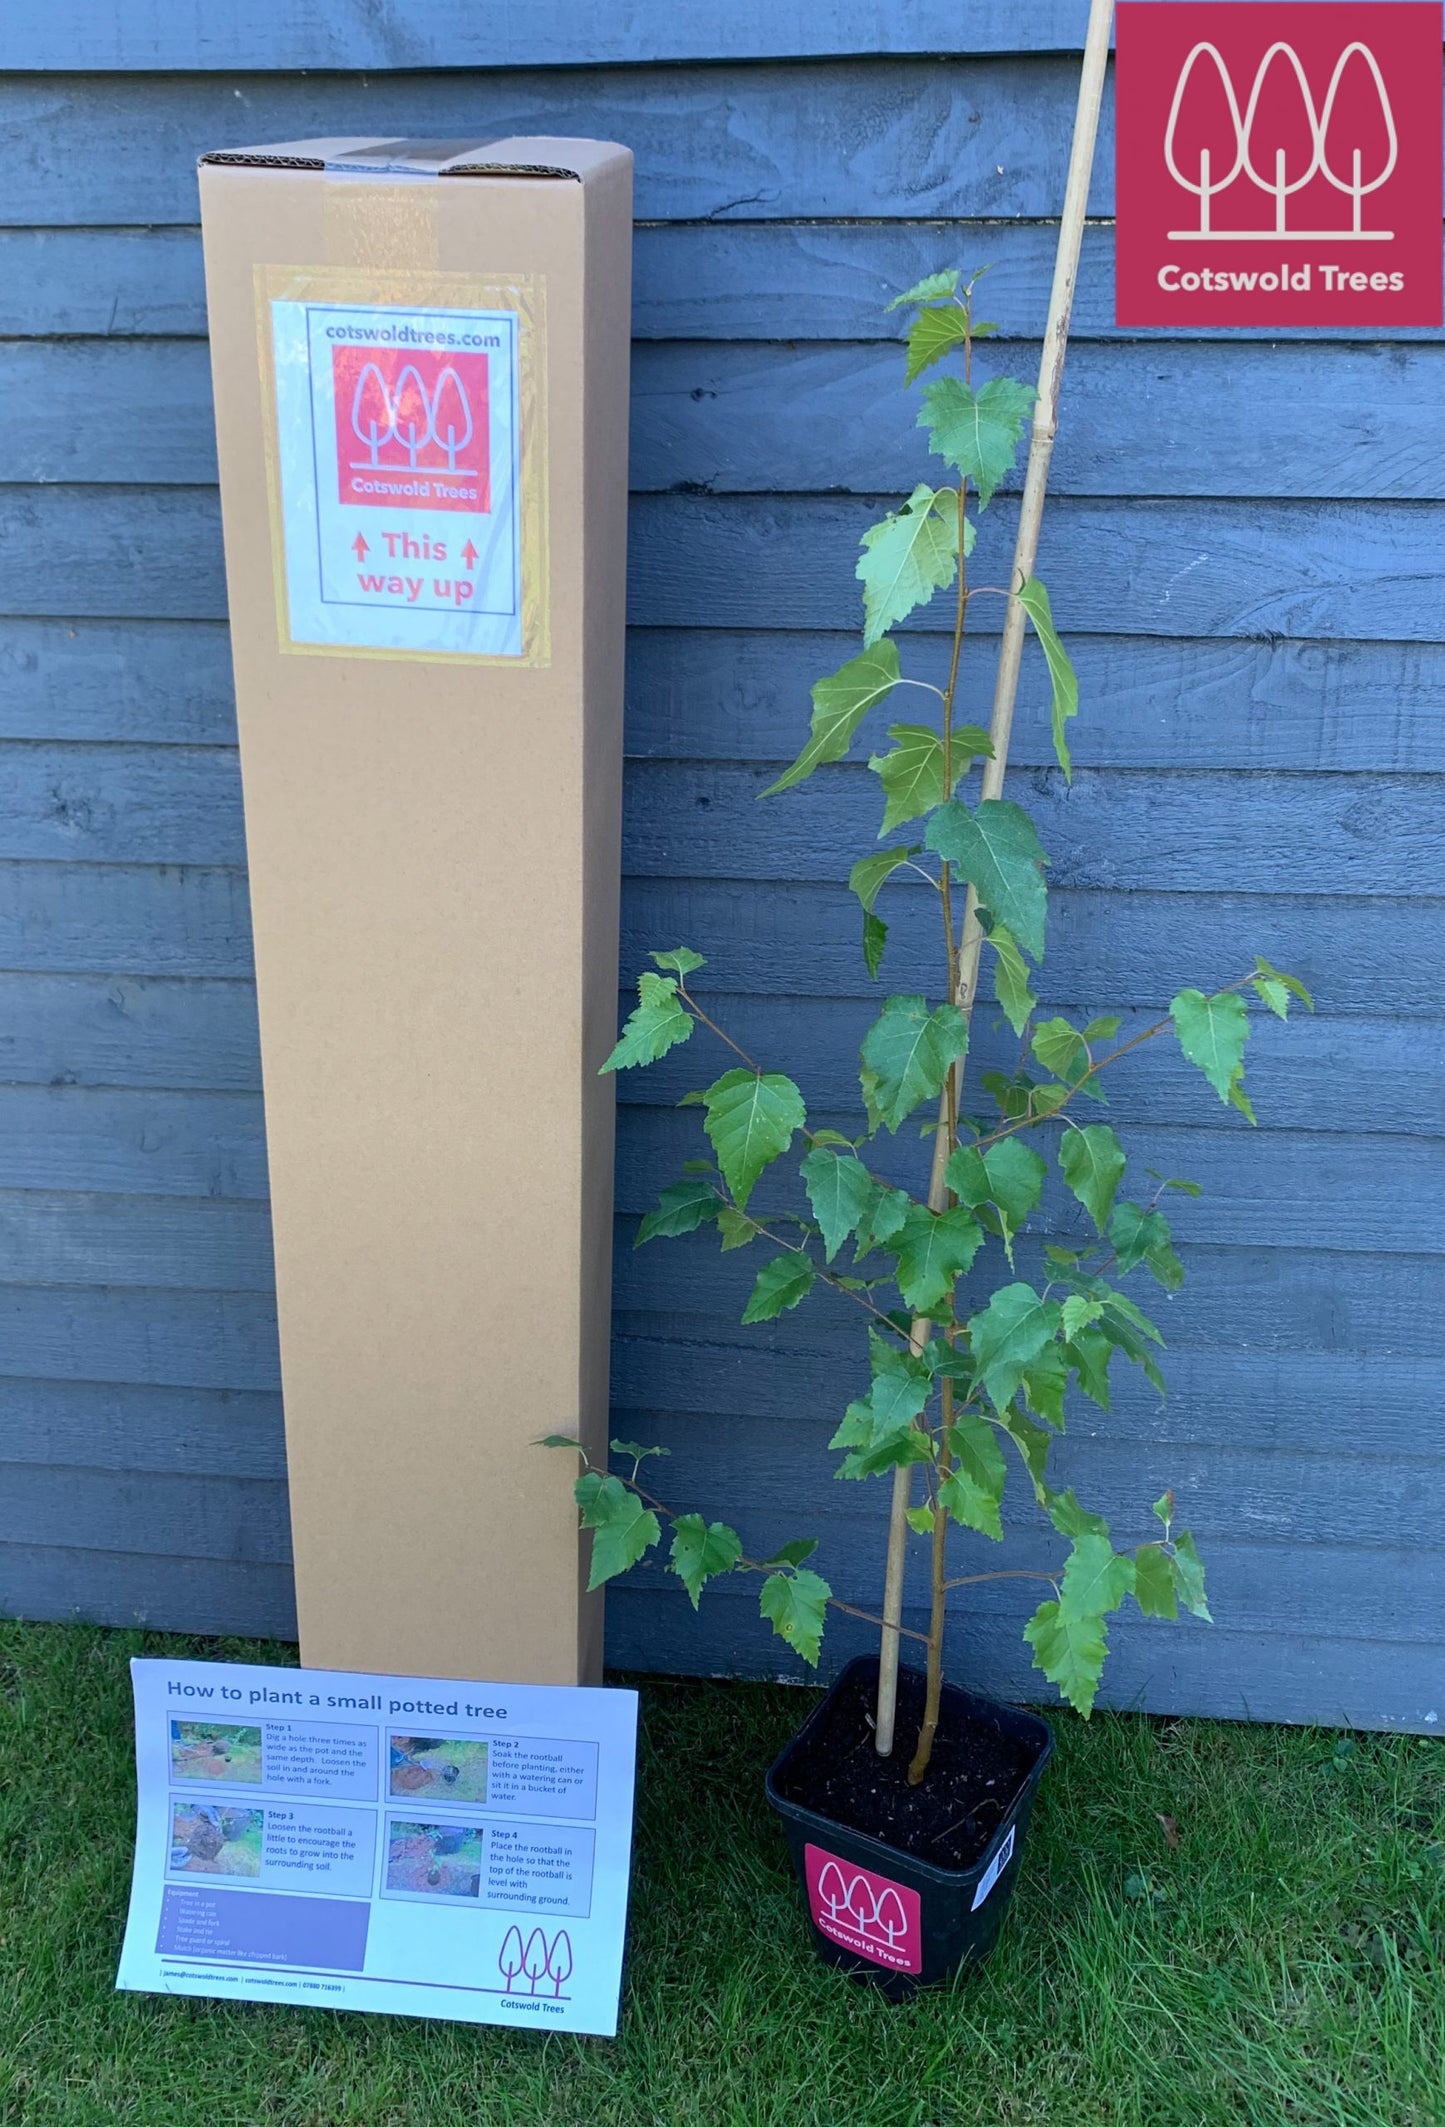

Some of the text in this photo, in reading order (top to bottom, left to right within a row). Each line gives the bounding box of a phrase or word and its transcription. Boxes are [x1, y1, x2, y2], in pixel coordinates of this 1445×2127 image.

[326, 324, 501, 348] cotswoldtrees.com
[352, 478, 477, 500] Cotswold Trees
[381, 531, 448, 561] This
[357, 572, 474, 606] way up
[167, 1681, 508, 1719] How to plant a small potted tree
[266, 1723, 284, 1732] Step
[266, 1734, 280, 1742] Dig
[289, 1734, 307, 1743] hole
[309, 1736, 331, 1744] three
[333, 1738, 356, 1746] times
[493, 1739, 512, 1749] Step
[266, 1743, 286, 1752] wide
[299, 1745, 312, 1753] the
[315, 1748, 329, 1756] pot
[331, 1747, 347, 1756] and
[349, 1748, 363, 1757] the
[492, 1749, 563, 1762] Soak the rootball
[321, 1757, 350, 1766] Loosen
[352, 1759, 366, 1767] the
[492, 1760, 585, 1775] before planting, either
[266, 1763, 282, 1771] soil
[292, 1765, 308, 1773] and
[310, 1766, 339, 1775] around
[341, 1767, 355, 1776] the
[266, 1774, 284, 1782] hole
[287, 1775, 305, 1784] with
[313, 1777, 332, 1786] fork.
[492, 1770, 511, 1779] with
[519, 1772, 556, 1784] watering
[557, 1776, 572, 1784] can
[574, 1777, 583, 1785] or
[491, 1781, 502, 1789] sit
[504, 1782, 510, 1790] it
[528, 1784, 556, 1794] bucket
[558, 1786, 566, 1794] of
[491, 1792, 516, 1801] water.
[268, 1811, 294, 1820] Step 3
[268, 1823, 296, 1832] Loosen
[298, 1825, 311, 1833] the
[314, 1827, 346, 1835] rootball
[491, 1830, 510, 1839] Step
[298, 1838, 340, 1848] encourage
[491, 1842, 512, 1851] Place
[515, 1844, 528, 1852] the
[530, 1846, 562, 1855] rootball
[266, 1847, 287, 1855] roots
[322, 1851, 338, 1859] into
[341, 1852, 354, 1860] the
[265, 1859, 332, 1871] surrounding soil.
[490, 1854, 504, 1862] the
[506, 1855, 524, 1863] hole
[538, 1858, 554, 1866] that
[556, 1859, 570, 1867] the
[490, 1866, 503, 1875] top
[516, 1868, 530, 1876] the
[532, 1870, 564, 1879] rootball
[488, 1877, 528, 1888] level with
[487, 1891, 570, 1905] surrounding ground.
[818, 1917, 911, 1967] Cotswold Trees
[245, 1977, 297, 1988] cotswoldtrees.com
[500, 1999, 564, 2013] Cotswold Trees
